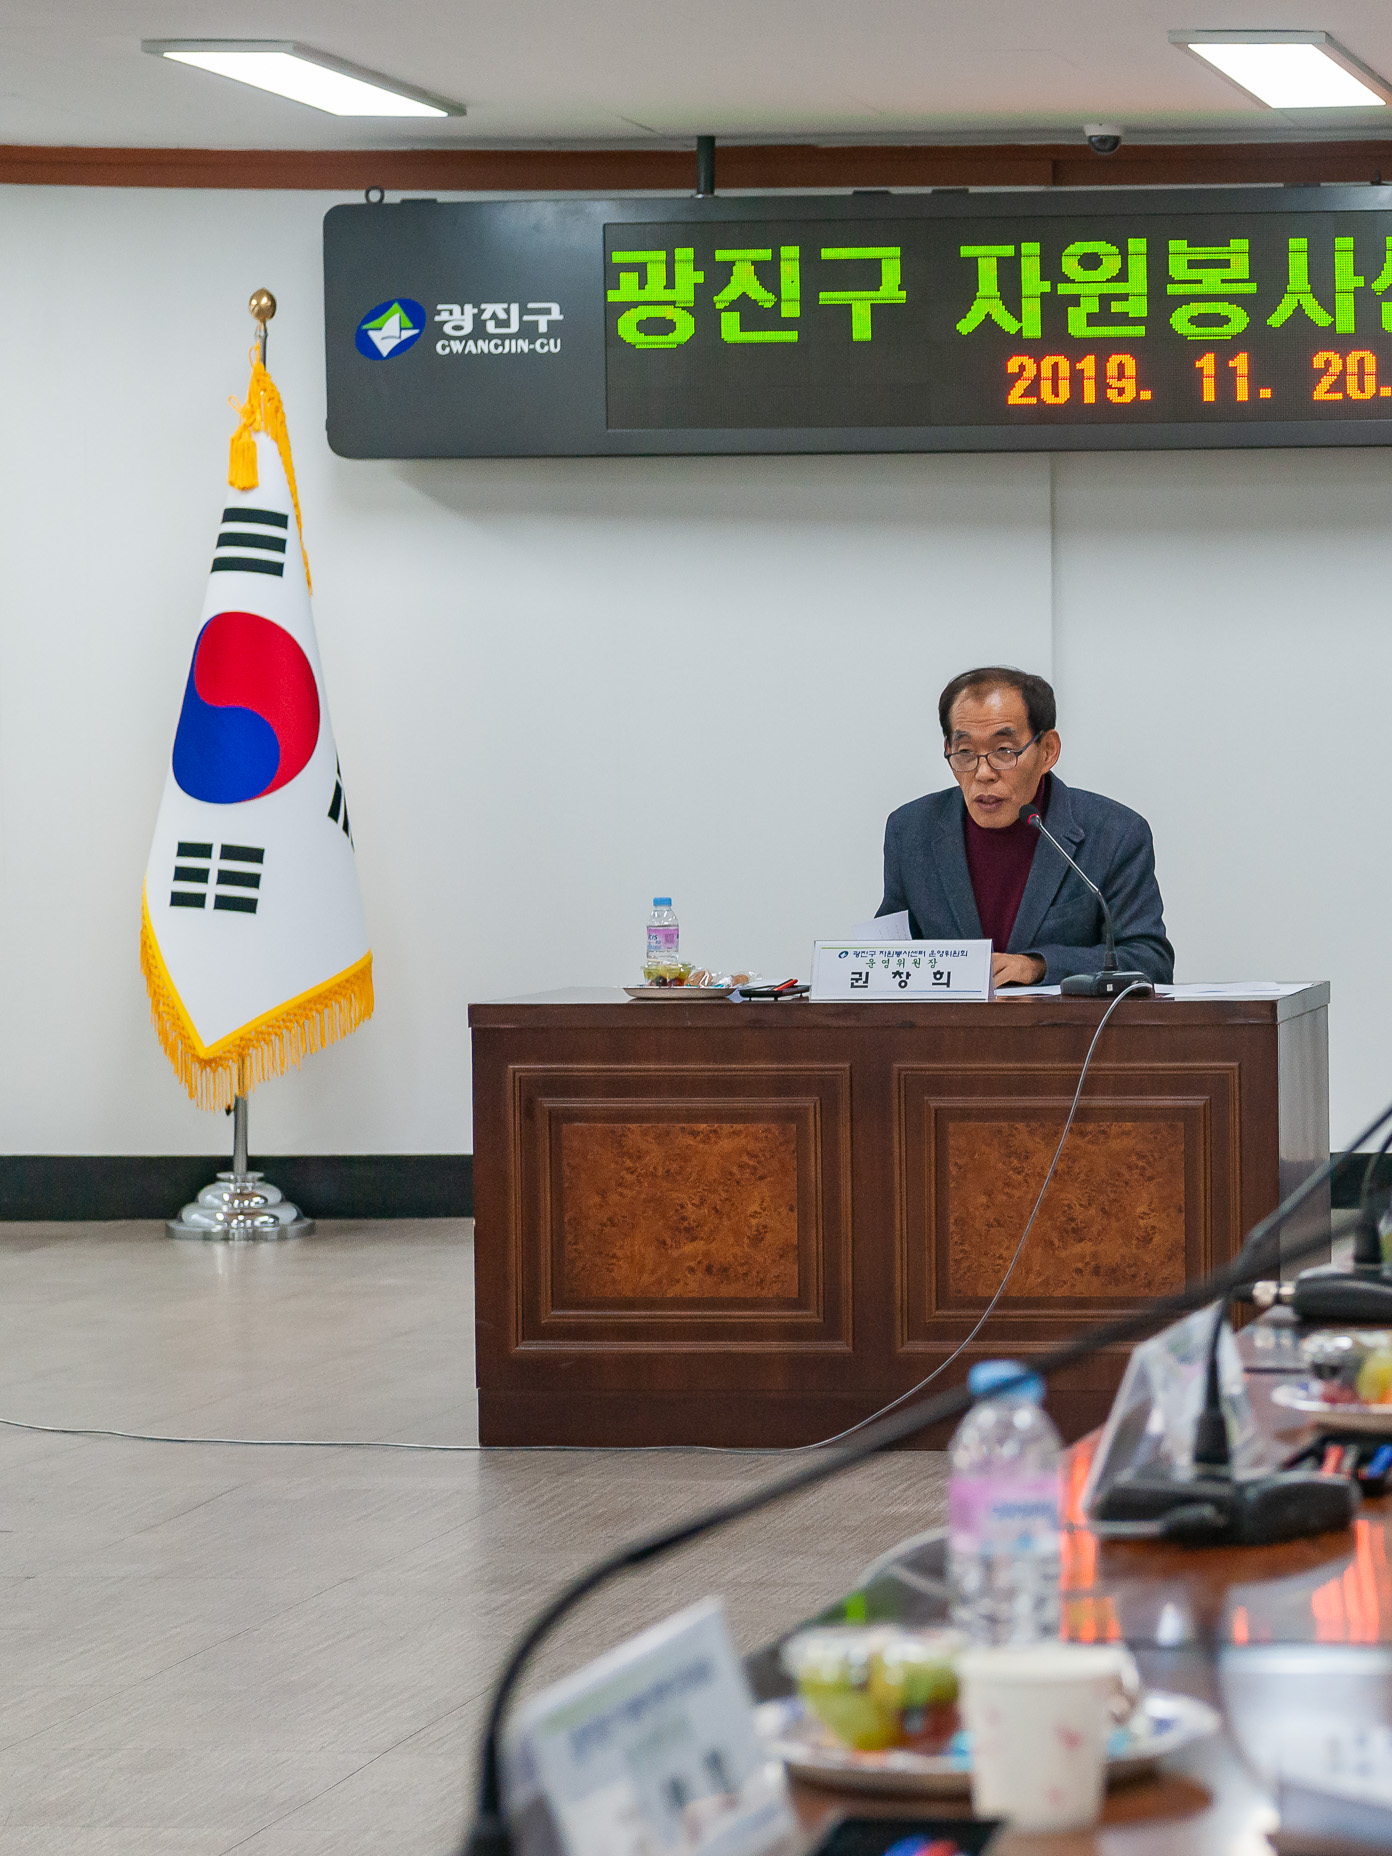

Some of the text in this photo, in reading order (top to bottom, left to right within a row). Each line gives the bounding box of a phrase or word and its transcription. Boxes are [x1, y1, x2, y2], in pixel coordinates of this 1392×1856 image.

[606, 245, 907, 349] 광진구
[434, 302, 564, 337] 광진구
[435, 338, 562, 356] GWANGJIN-GU
[1006, 353, 1153, 406] 2019.
[1194, 352, 1272, 402] 11.
[852, 950, 877, 958] 광진구
